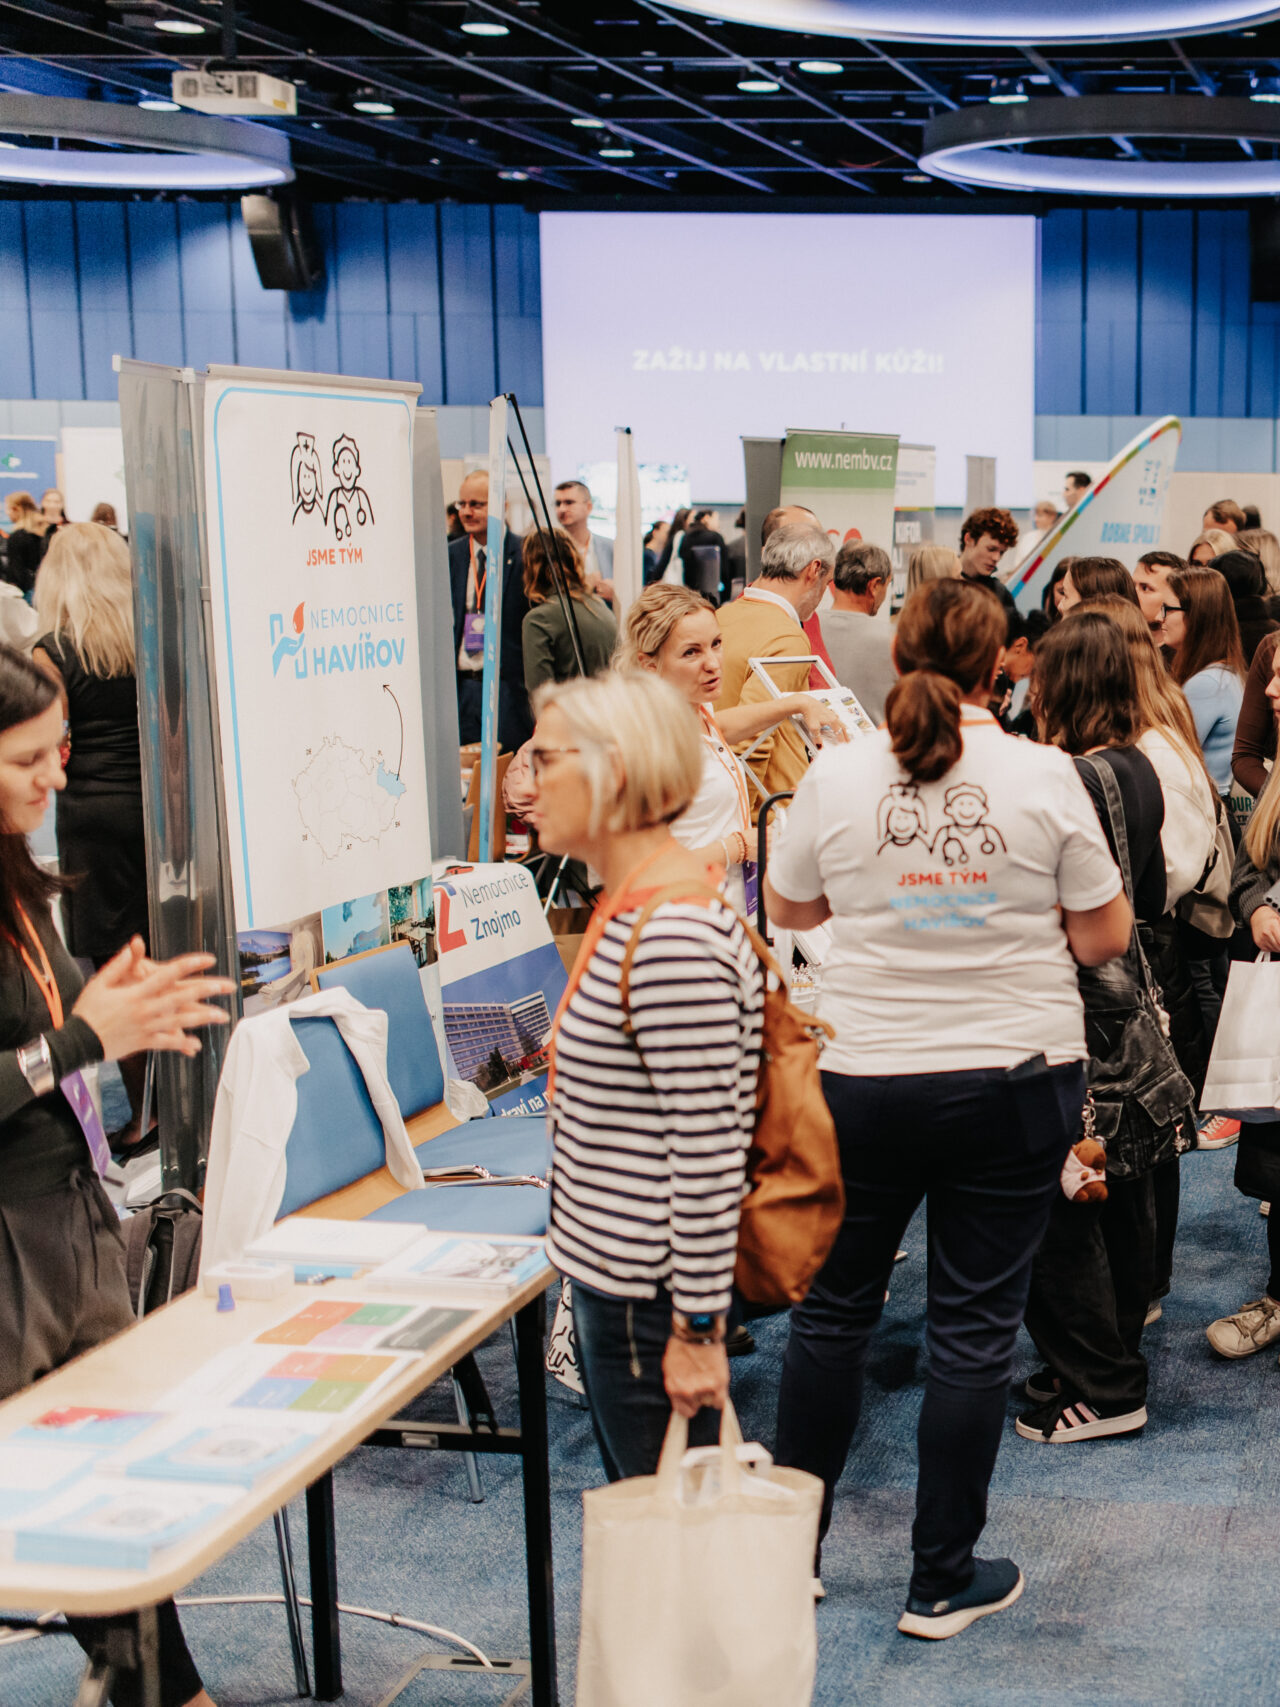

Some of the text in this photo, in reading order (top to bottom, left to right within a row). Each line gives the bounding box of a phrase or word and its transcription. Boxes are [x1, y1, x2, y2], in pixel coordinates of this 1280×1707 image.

[632, 345, 707, 372] ZAŽIJ
[713, 350, 752, 372] NA
[758, 348, 869, 374] VLASTNÍ
[794, 449, 894, 471] www.nembv.cz
[306, 542, 363, 567] JSME TÝM
[310, 602, 405, 630] NEMOCNICE
[312, 631, 406, 677] HAVÍŘOV
[459, 872, 530, 909] Nemocnice
[897, 868, 988, 887] JSME TÝM
[469, 909, 522, 941] Znojmo
